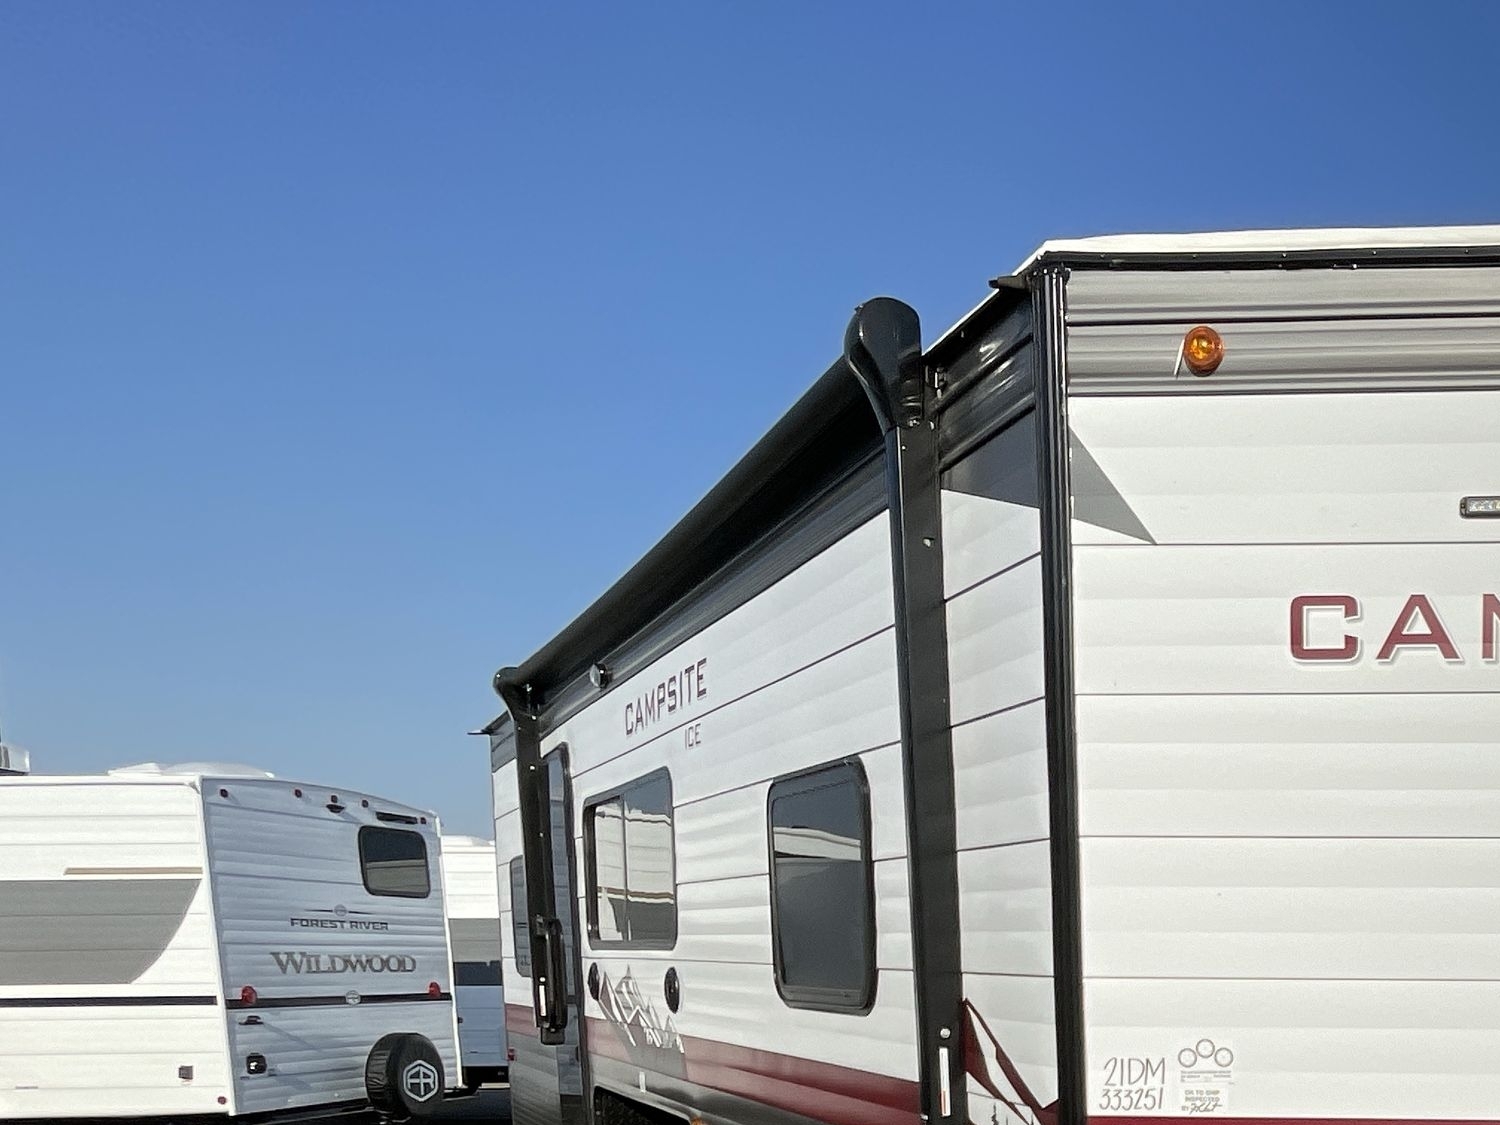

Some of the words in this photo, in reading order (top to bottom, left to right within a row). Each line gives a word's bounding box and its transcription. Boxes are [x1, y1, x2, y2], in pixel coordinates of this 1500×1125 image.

[625, 657, 707, 735] CAMPSITE
[684, 723, 701, 750] ICE
[290, 918, 346, 929] FOREST
[350, 920, 389, 931] RIVER
[270, 952, 417, 974] WILDWOOD
[1103, 1057, 1166, 1087] 21DM
[1099, 1087, 1164, 1111] 333251
